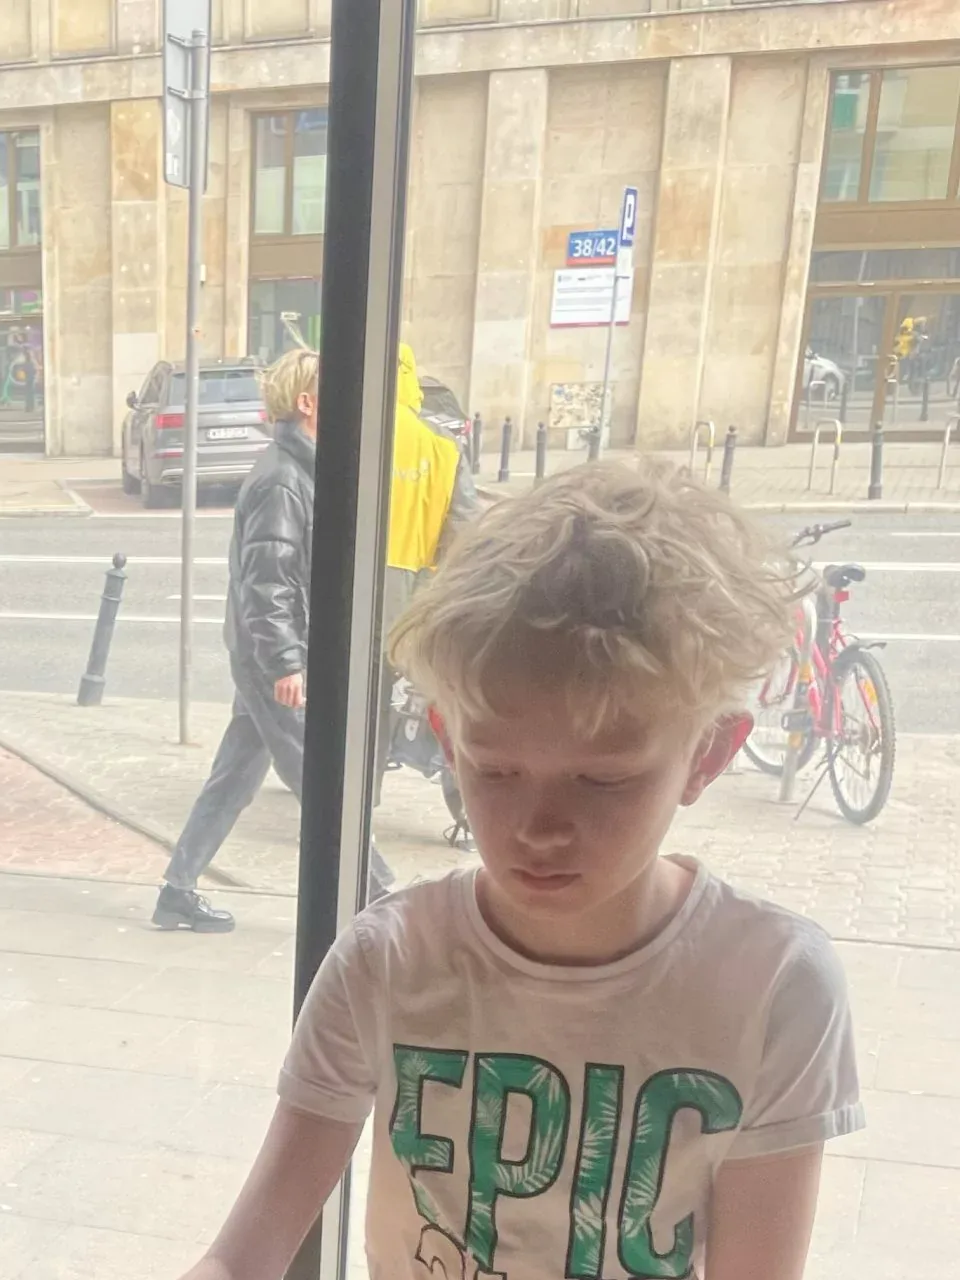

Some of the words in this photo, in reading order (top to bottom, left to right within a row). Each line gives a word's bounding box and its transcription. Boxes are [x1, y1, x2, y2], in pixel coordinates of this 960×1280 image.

[622, 194, 635, 240] P
[571, 237, 616, 257] 38/42
[388, 1043, 744, 1280] EPIC
